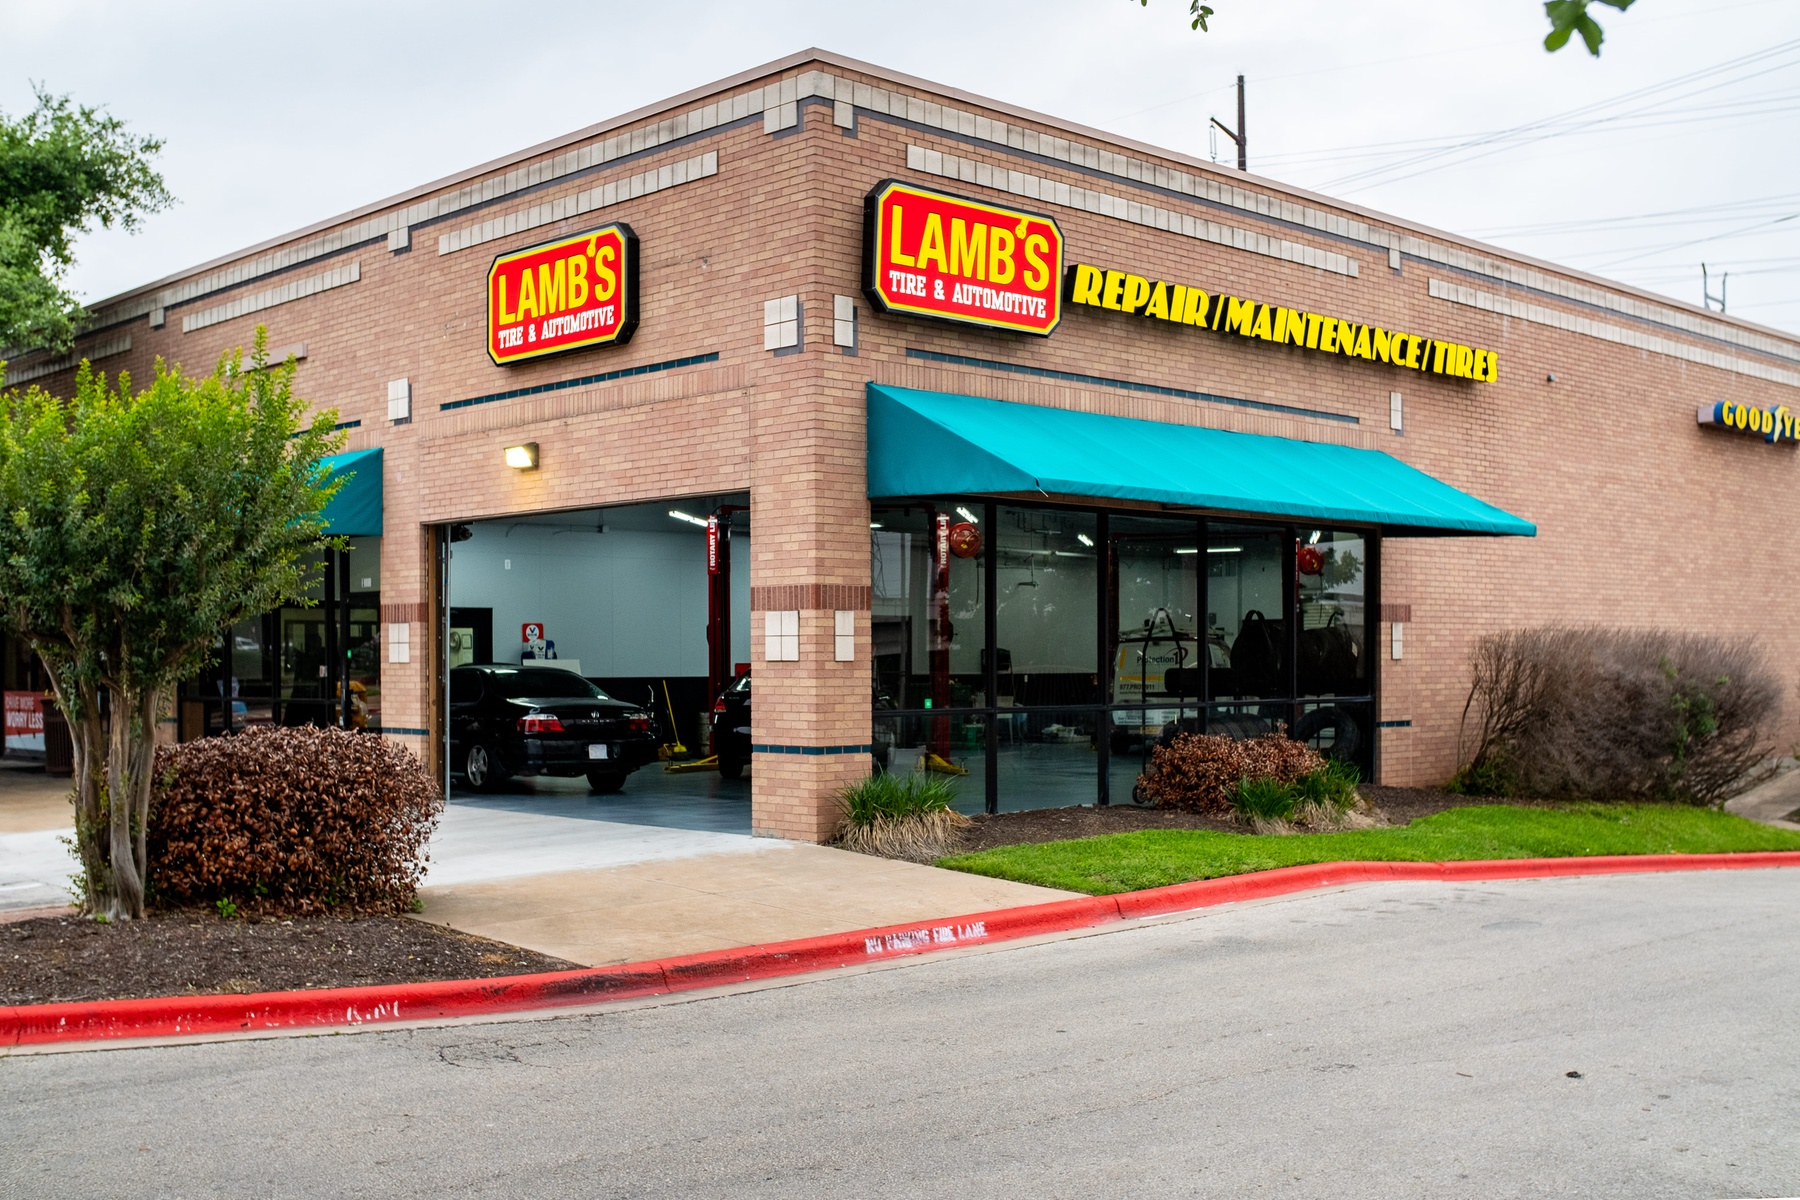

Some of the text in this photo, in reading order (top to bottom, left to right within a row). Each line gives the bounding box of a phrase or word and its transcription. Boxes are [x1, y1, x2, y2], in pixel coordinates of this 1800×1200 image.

[890, 204, 1050, 292] LAMB'S
[498, 238, 617, 326] LAMB'S
[889, 270, 1047, 319] TIRE & AUTOMOTIVE
[498, 304, 615, 349] TIRE & AUTOMOTIVE
[28, 712, 44, 729] LESS
[957, 922, 988, 940] LANE
